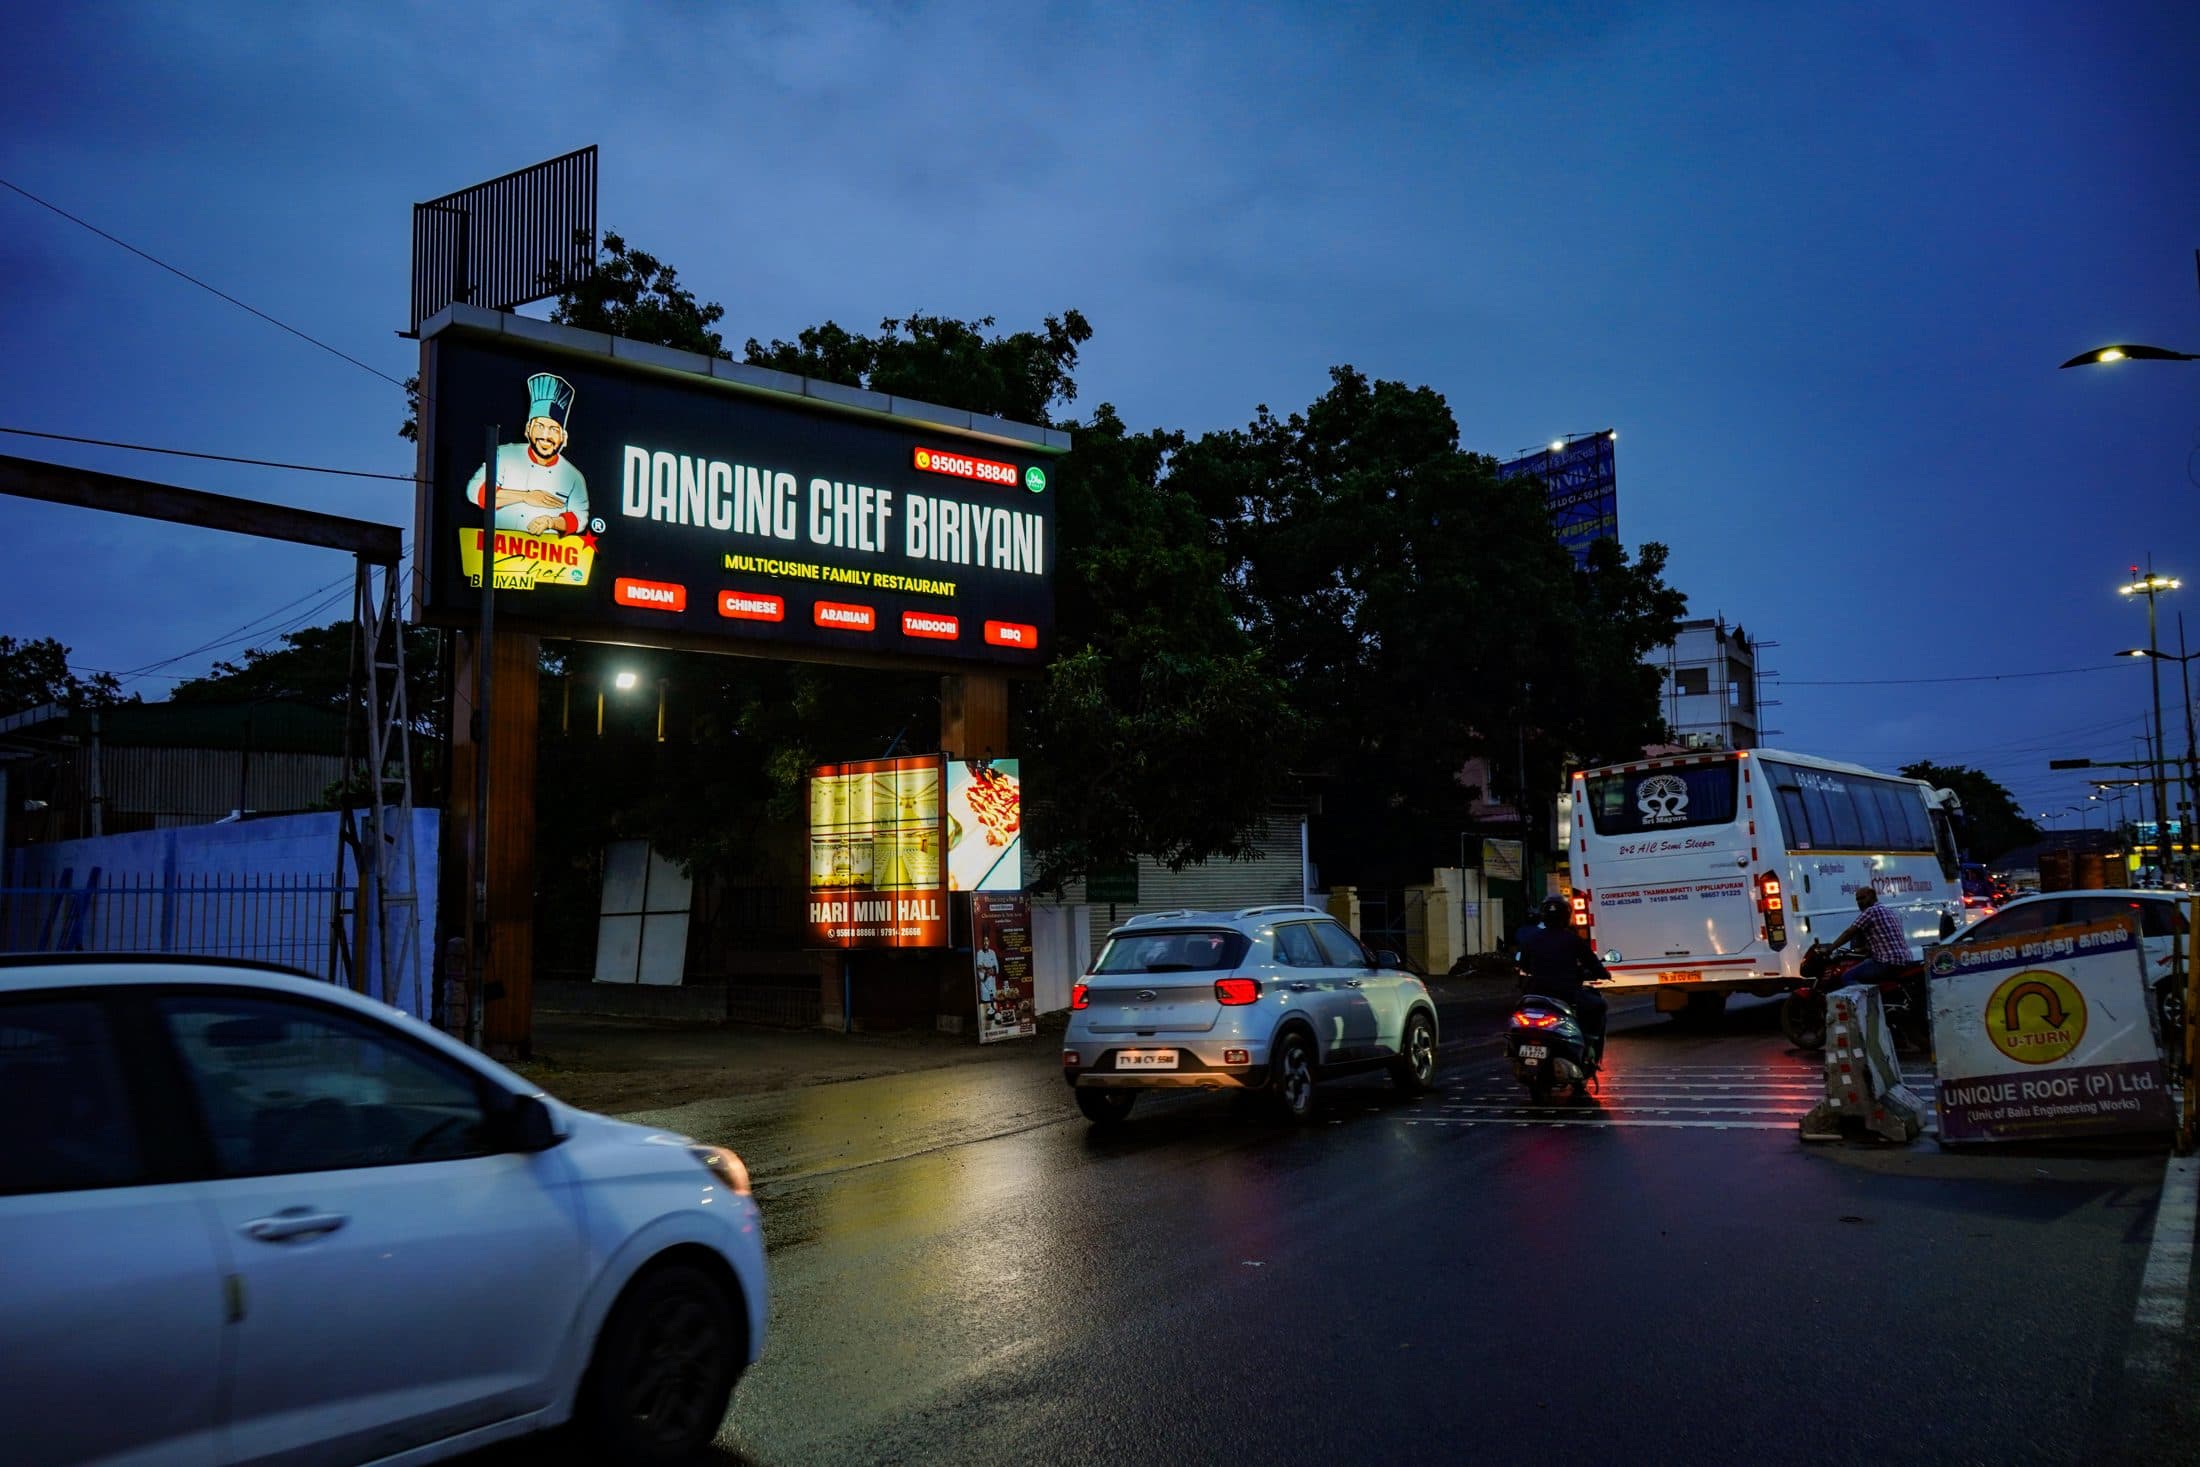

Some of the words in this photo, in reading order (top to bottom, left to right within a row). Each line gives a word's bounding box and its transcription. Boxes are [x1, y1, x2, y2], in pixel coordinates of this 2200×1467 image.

[931, 454, 973, 476] 95005
[976, 463, 1016, 484] 58840
[622, 445, 797, 541] DANCING
[809, 478, 892, 553] CHEF
[906, 493, 1043, 575] BIRIYANI
[471, 573, 534, 588] BIYANI
[725, 553, 819, 579] MULTICUSINE
[822, 567, 871, 586] FAMILY
[874, 573, 956, 597] RESTAURANT
[627, 586, 674, 603] INDIAN
[726, 598, 777, 614] CHINESE
[820, 608, 869, 625] ARABIAN
[905, 617, 956, 634] TANDOORI
[1000, 627, 1021, 642] BBQ
[1642, 817, 1655, 825] Sri
[1656, 815, 1687, 824] Mayura
[1637, 841, 1657, 854] A/C
[1661, 840, 1682, 851] Semi
[1684, 838, 1715, 850] Sleeper
[810, 902, 848, 923] HARI
[853, 901, 892, 922] MINI
[897, 899, 940, 921] HALL
[1960, 946, 2016, 967] கோவை
[2021, 937, 2074, 959] மாநகர
[2079, 924, 2128, 948] காவல்
[2007, 1031, 2070, 1048] U-TURN
[1944, 1083, 2017, 1107] UNIQUE
[2022, 1077, 2080, 1100] ROOF
[2085, 1072, 2113, 1097] (P)
[2118, 1071, 2159, 1092] Ltd.
[1994, 1107, 2006, 1119] of
[2007, 1105, 2031, 1119] Balu
[2033, 1100, 2097, 1117] Engineering
[2100, 1097, 2141, 1113] Works)
